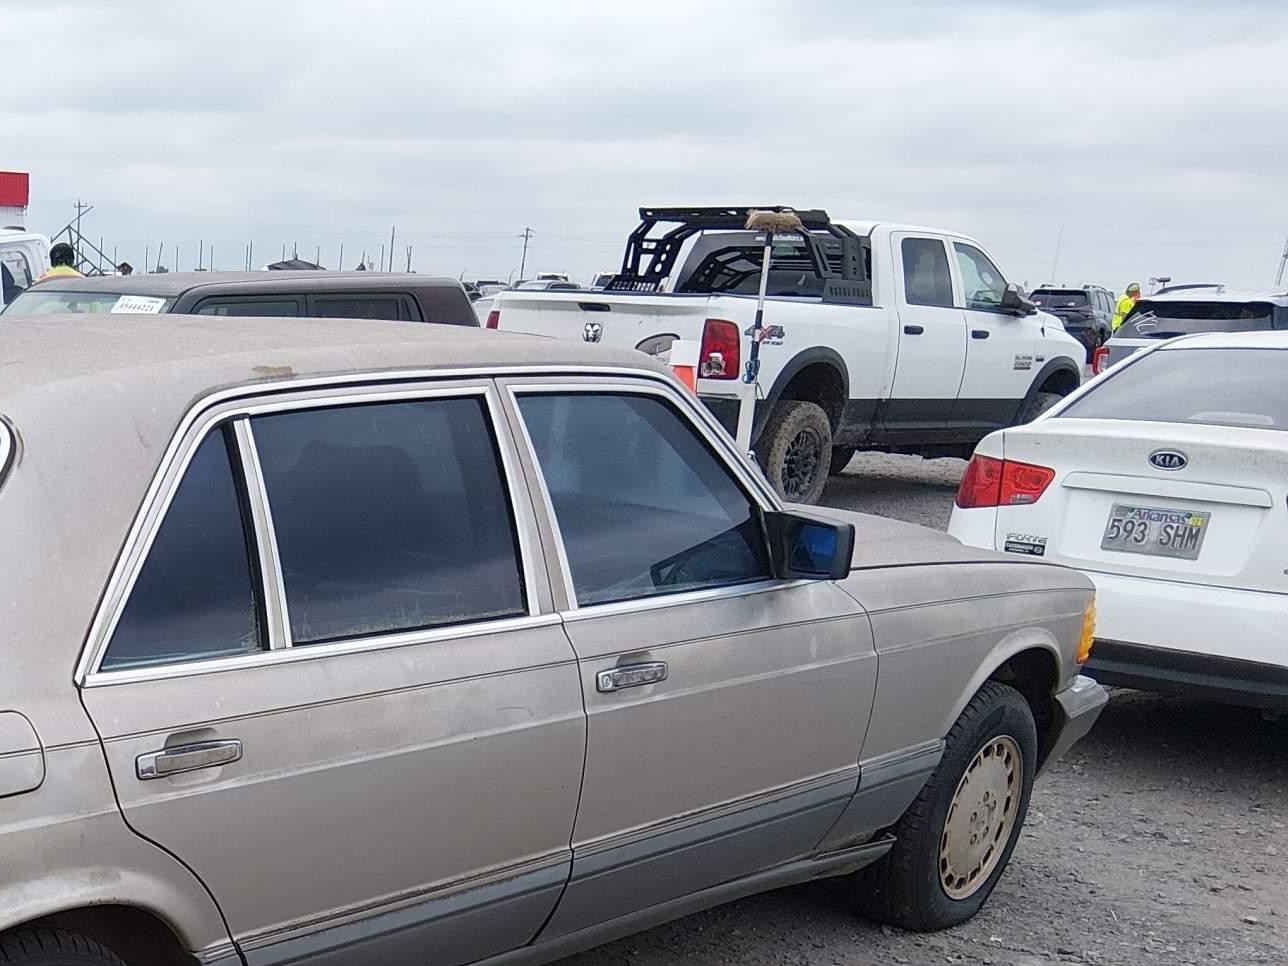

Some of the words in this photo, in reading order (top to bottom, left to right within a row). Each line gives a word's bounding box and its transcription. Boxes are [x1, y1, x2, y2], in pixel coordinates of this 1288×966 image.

[1155, 454, 1181, 467] KIA
[1133, 507, 1189, 524] Arkansas
[1107, 518, 1149, 544] 593
[1158, 523, 1202, 550] SHM
